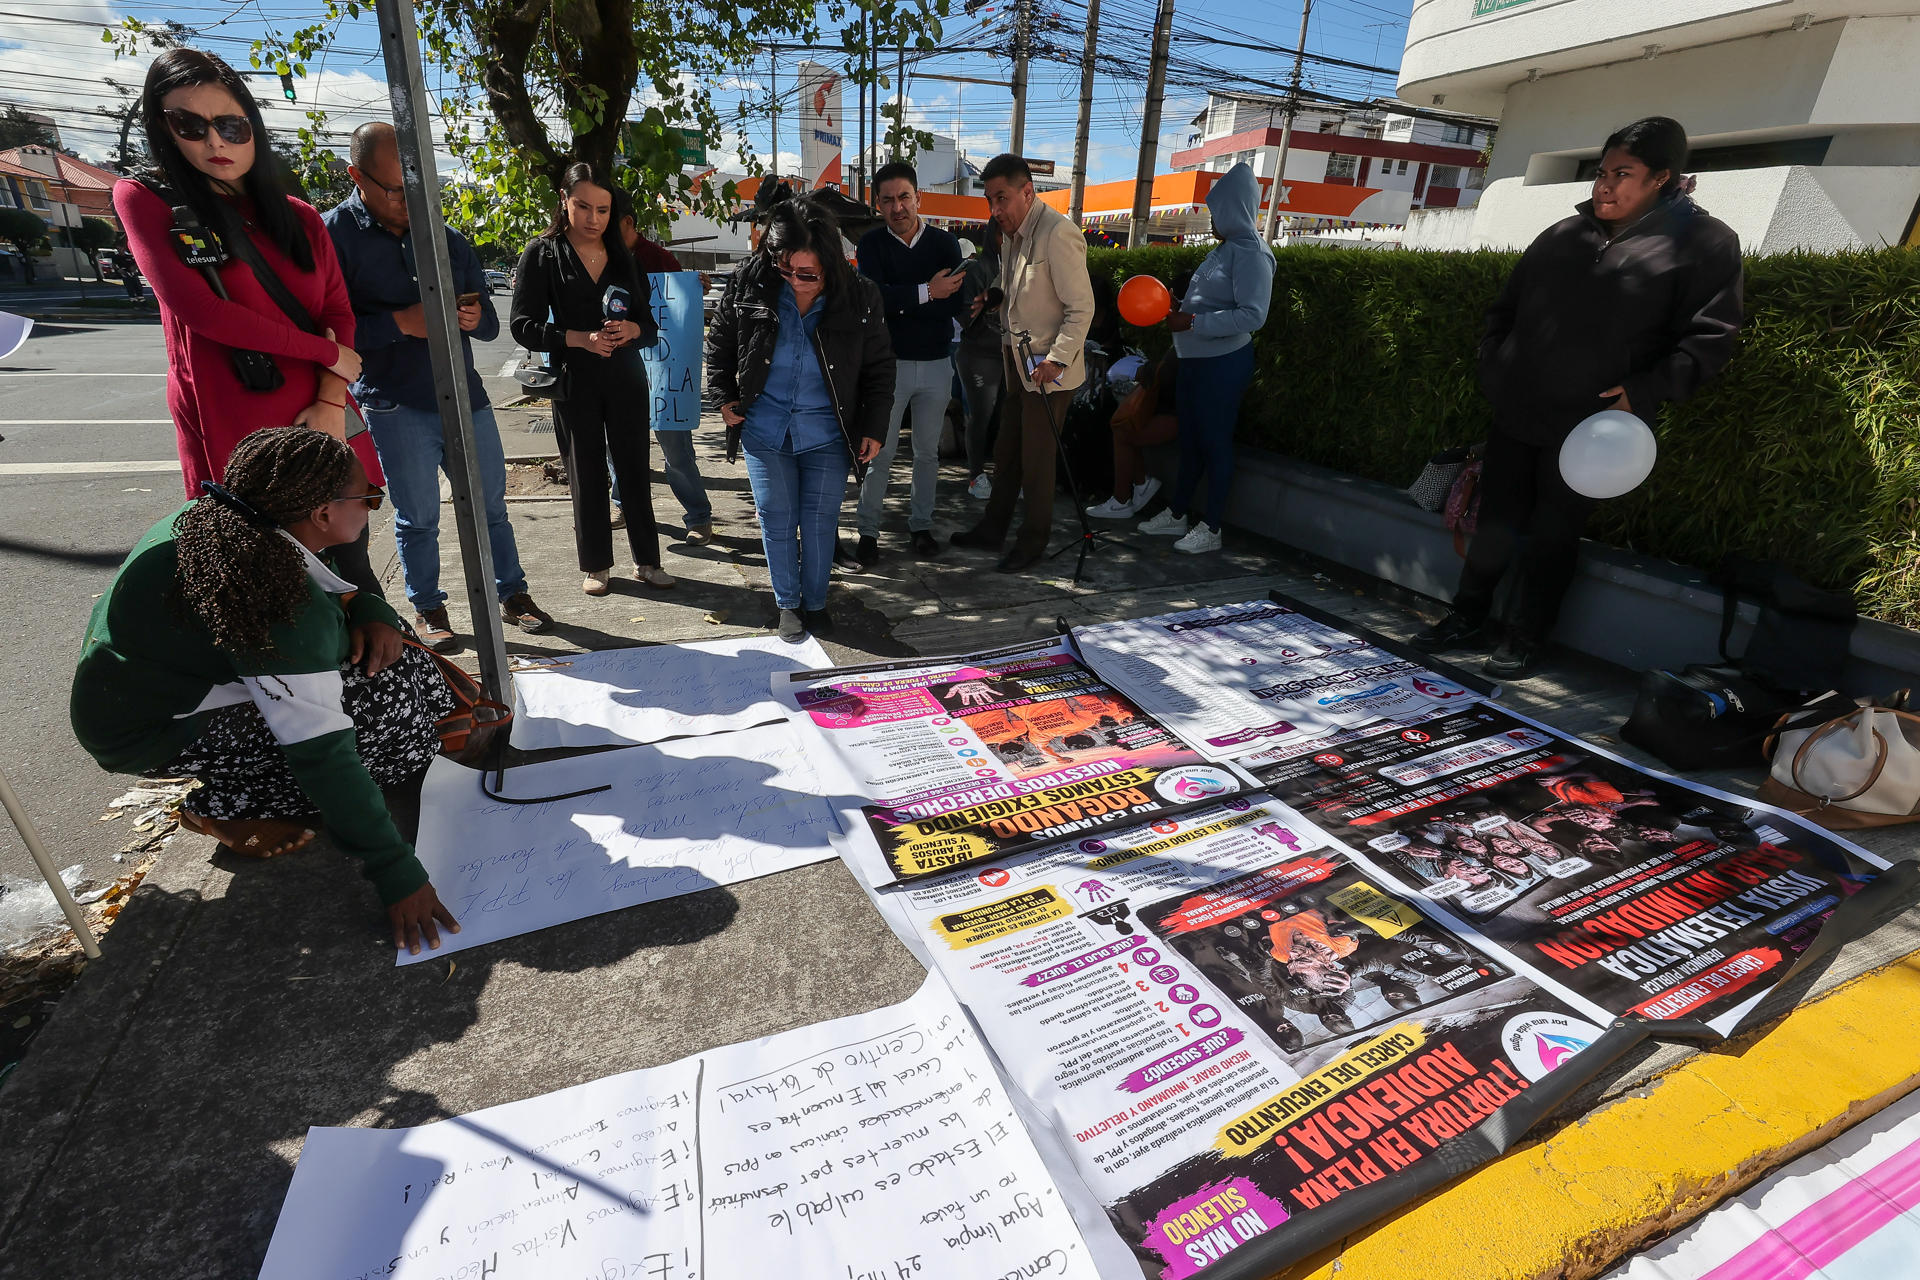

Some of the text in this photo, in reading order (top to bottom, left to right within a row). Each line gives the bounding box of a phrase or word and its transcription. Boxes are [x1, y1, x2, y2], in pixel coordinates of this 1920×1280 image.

[815, 129, 842, 148] PRIMAX
[1024, 680, 1072, 696] TORTURA
[1031, 689, 1086, 703] DERECHOS,
[948, 701, 1017, 718] PRIVILEGIOS
[891, 760, 1122, 824] NUESTROS DERECHOS
[914, 769, 1142, 835] ESTAMOS EXIGIENDO
[977, 785, 1151, 843] ROGANDO,
[1220, 810, 1268, 829] EXIGIMOS
[909, 837, 957, 851] SILENCIO!
[1169, 829, 1209, 845] ESTADO
[912, 846, 954, 858] ABUSOS
[1091, 839, 1171, 865] ECUATORIANO:
[1711, 840, 1802, 887] BAJO
[1737, 870, 1828, 910] VISITA
[959, 902, 1010, 921] IMPUNIDAD.
[987, 908, 1015, 920] PUEDE
[1006, 909, 1037, 924] SILENCIO
[1018, 913, 1051, 926] TORTURA
[952, 915, 987, 930] QUEDAR
[970, 921, 1005, 933] TAMBIÉN.
[963, 929, 995, 944] CRIMEN.
[1109, 936, 1138, 953] ¿QUÉ
[1597, 902, 1764, 981] TELEMÁTICA
[1085, 949, 1110, 962] DIJO
[1033, 963, 1071, 982] JUEZ?
[1432, 965, 1473, 984] TELEMÁTICA
[1444, 971, 1480, 990] AUDIENCIA
[1640, 948, 1727, 994] DENUNCIA PÚBLICA
[1643, 955, 1764, 1020] CÁRCEL DEL ENCUENTRO
[1237, 993, 1266, 1006] POLICÍA
[1120, 1020, 1165, 1042] aparecieron
[1175, 1023, 1190, 1037] 1
[1516, 1022, 1532, 1033] vida
[1531, 1018, 1549, 1026] una
[944, 1036, 964, 1051] La
[1093, 1041, 1119, 1053] detrás
[1145, 1039, 1167, 1052] plena
[1510, 1033, 1523, 1052] digna
[1092, 1048, 1125, 1065] vestidos
[1106, 1051, 1144, 1071] audiencia
[1139, 1031, 1233, 1082] ¿QUÉ SUCEDIÓ?
[1220, 1050, 1251, 1069] HECHO
[893, 1058, 941, 1085] Cárcel
[1055, 1066, 1078, 1081] negro
[1187, 1065, 1221, 1084] GRAVE,
[1238, 1061, 1260, 1073] varias
[1059, 1069, 1105, 1090] telemática,
[1208, 1071, 1238, 1088] cárceles
[1234, 1067, 1269, 1088] presencia
[973, 1088, 992, 1106] de
[1137, 1081, 1189, 1111] INHUMANO
[1197, 1089, 1226, 1106] jueces,
[1225, 1087, 1260, 1108] audiencia
[1226, 1033, 1414, 1145] CÁRCEL DEL ENCUENTRO
[1128, 1103, 1177, 1130] constatamos
[1166, 1105, 1200, 1122] fiscales,
[1186, 1105, 1226, 1128] telemática
[1275, 1042, 1478, 1173] AUDIENCIA!
[748, 1122, 771, 1133] es
[939, 1112, 965, 1127] las
[1073, 1112, 1129, 1142] DELICTIVO.
[1129, 1121, 1167, 1144] abogados
[1150, 1126, 1186, 1148] realizada
[1290, 1059, 1530, 1209] ¡TORTURA EN PLENA
[843, 1126, 929, 1168] muertes
[1105, 1146, 1123, 1158] PPL
[1129, 1146, 1150, 1159] ayer,
[801, 1160, 832, 1184] por
[1113, 1157, 1129, 1169] con
[768, 1121, 1008, 1235] El Estado es culpable
[920, 1172, 1017, 1224] no un favor
[944, 1193, 1043, 1250] Agua limpia
[1162, 1187, 1247, 1245] SILENCIO
[1231, 1208, 1268, 1240] NO
